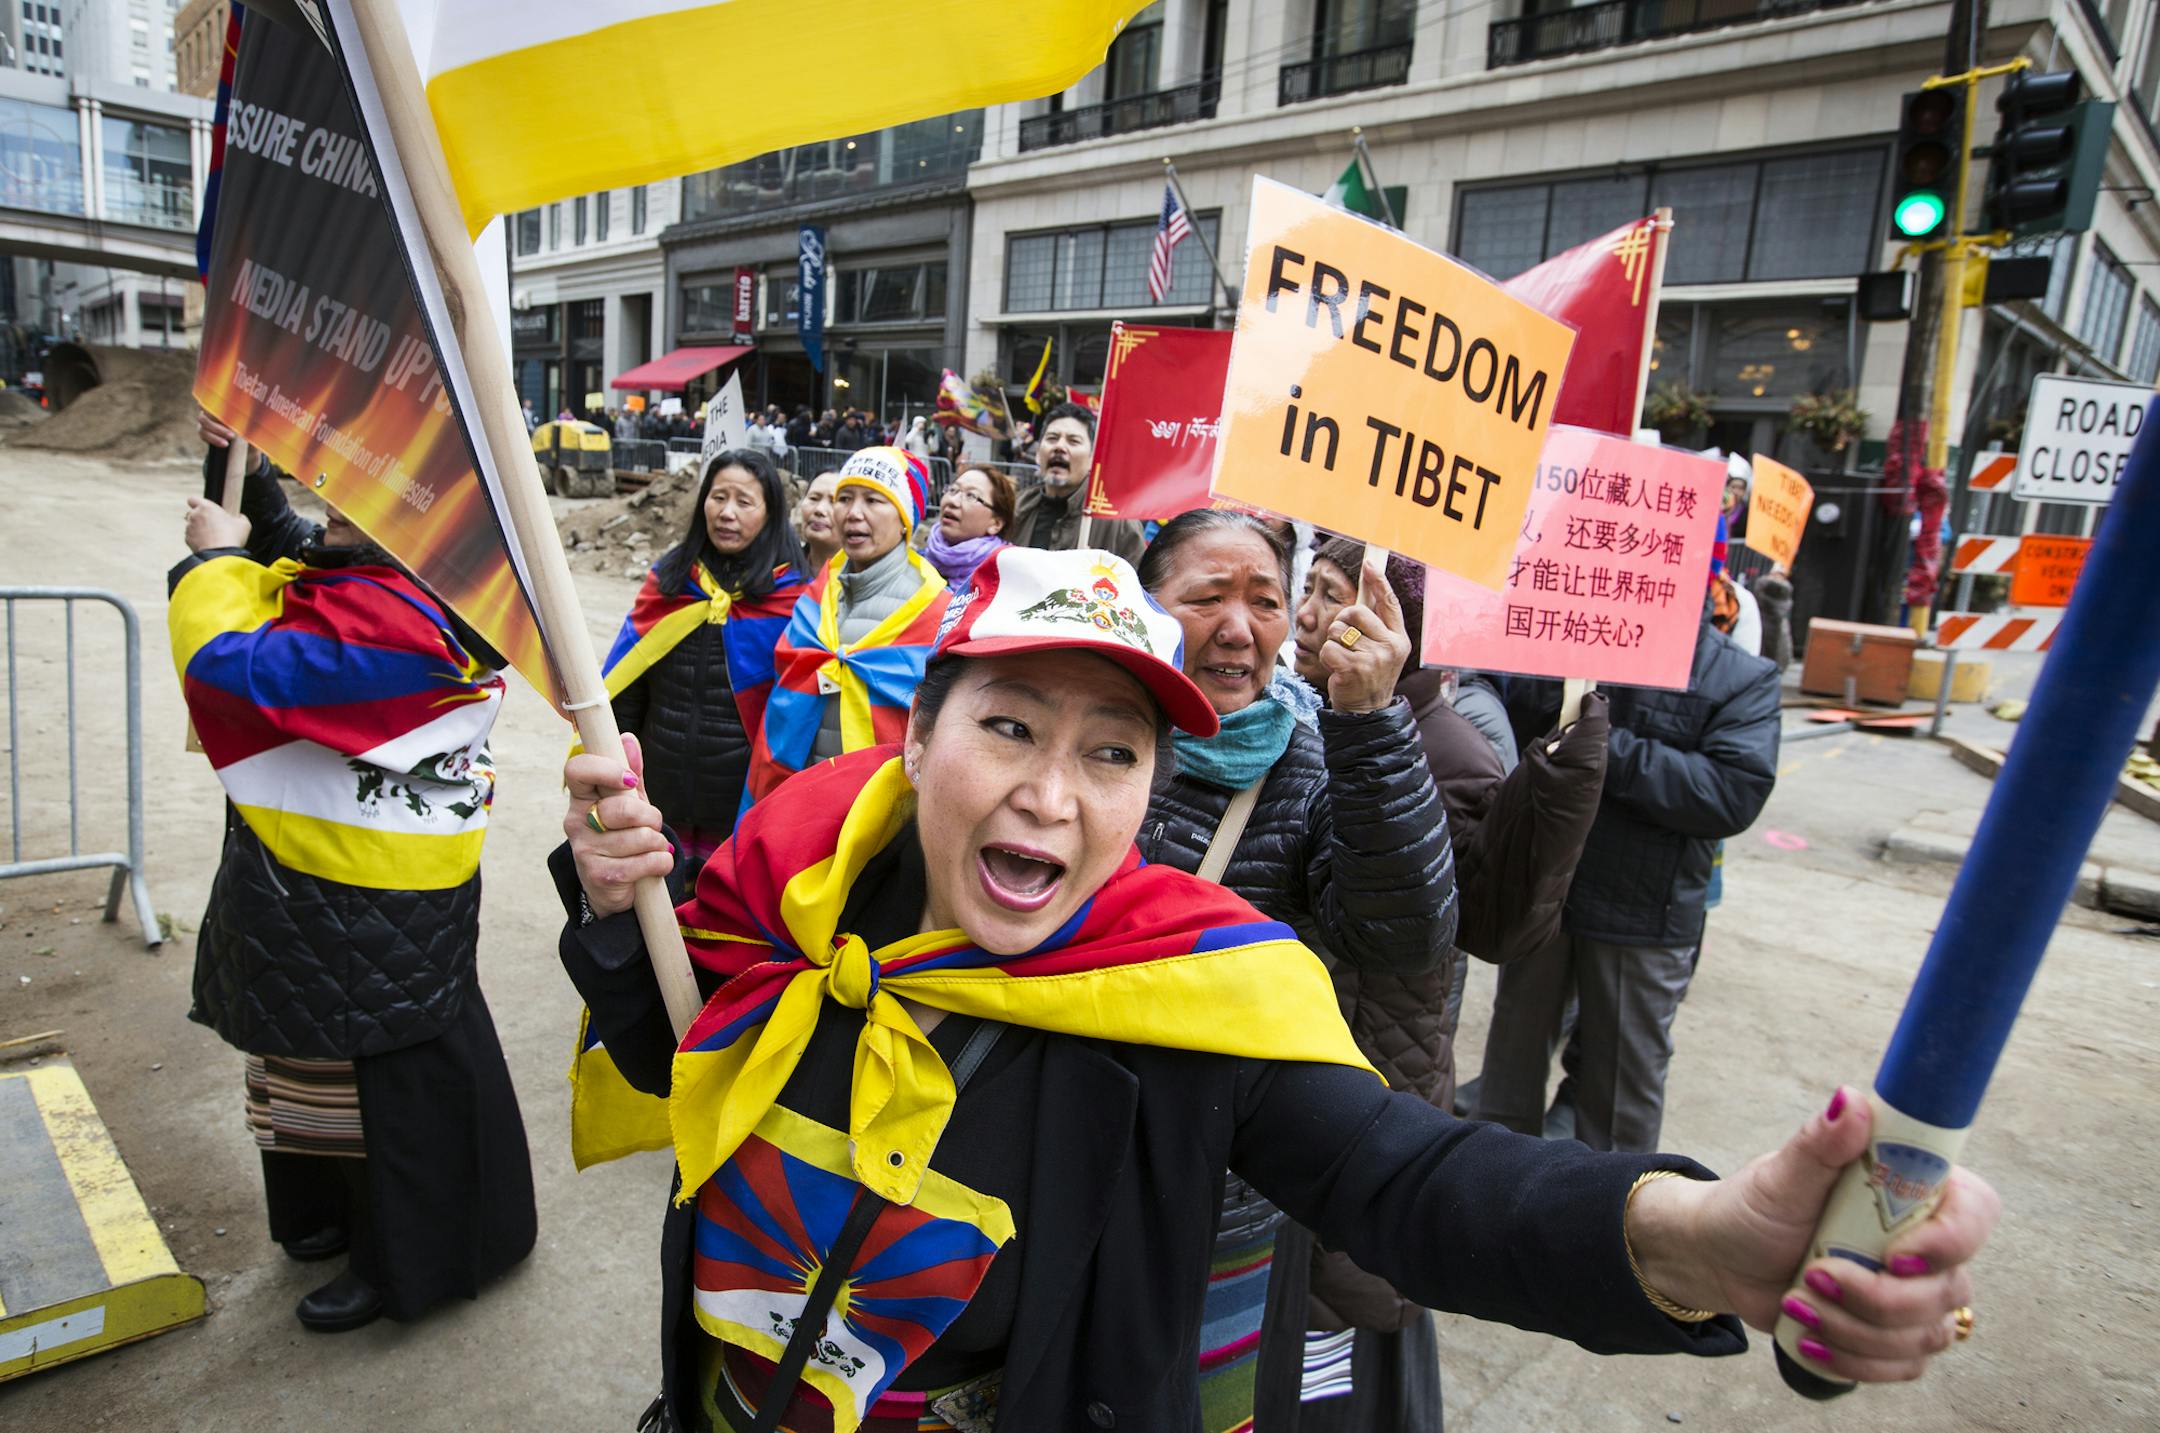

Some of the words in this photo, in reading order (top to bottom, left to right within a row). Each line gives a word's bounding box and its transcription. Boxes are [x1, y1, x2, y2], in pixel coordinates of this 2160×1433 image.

[227, 98, 306, 167] SSURE
[735, 275, 752, 321] barrio
[231, 258, 310, 335] MEDIA
[304, 294, 391, 373] STAND
[384, 333, 434, 391] UP
[1265, 244, 1548, 431] FREEDOM
[710, 395, 729, 425] THE
[2056, 397, 2144, 437] ROAD
[233, 361, 269, 402] Tibetan
[266, 384, 315, 432] American
[312, 412, 373, 471] Foundation
[367, 452, 387, 476] of
[379, 453, 436, 514] Minnesota
[704, 430, 728, 461] EDIA
[1280, 383, 1340, 472] in
[1367, 416, 1501, 531] TIBET
[2030, 446, 2130, 486] CLOSE
[1505, 603, 1644, 648] 国开始关心?
